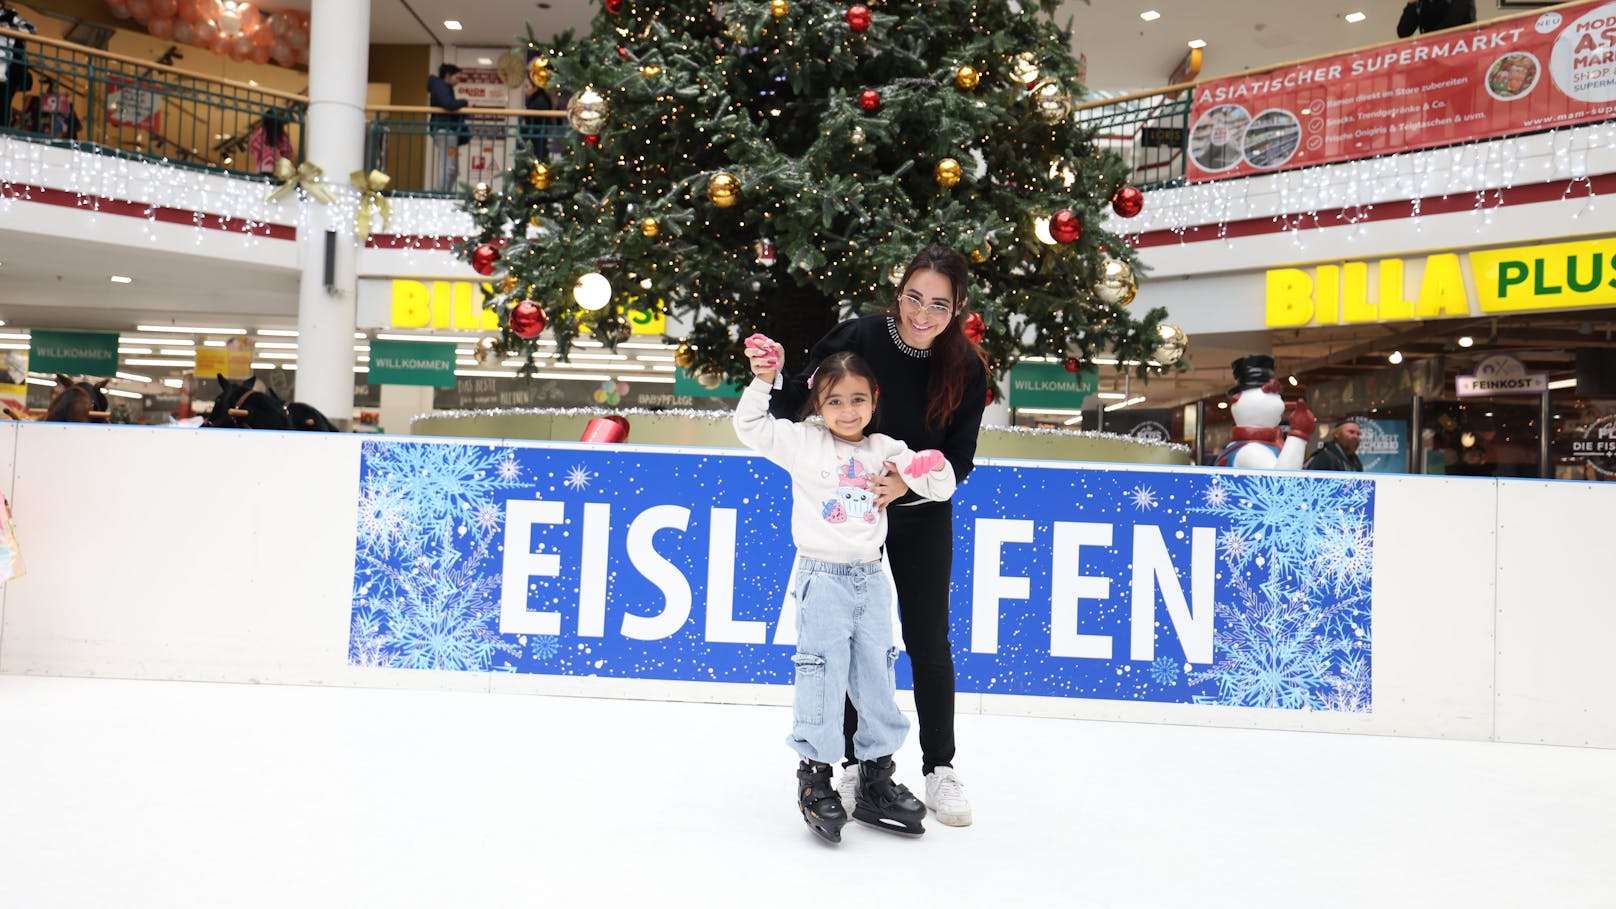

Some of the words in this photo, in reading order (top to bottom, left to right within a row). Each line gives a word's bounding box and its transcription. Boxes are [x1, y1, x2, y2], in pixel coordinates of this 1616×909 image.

[1536, 18, 1560, 28] NEU
[1200, 64, 1342, 104] ASIATISCHER
[1351, 28, 1525, 76] SUPERMARKT
[1574, 50, 1616, 70] MAR
[1573, 68, 1610, 83] SHOP
[1355, 90, 1381, 103] direkt
[1394, 85, 1420, 97] Store
[1421, 76, 1468, 93] zubereiten
[1422, 102, 1430, 111] &
[1432, 100, 1447, 109] Co.
[1354, 125, 1387, 139] Onigiris
[1388, 123, 1397, 133] &
[1399, 116, 1452, 132] Teigtaschen
[1453, 113, 1462, 123] &
[1266, 253, 1470, 328] BILLA
[1497, 252, 1616, 298] PLU
[37, 346, 113, 361] WILLKOMMEN
[375, 358, 450, 371] WILLKOMMEN
[1472, 378, 1532, 391] FEINKOST
[1573, 441, 1593, 451] DIE
[500, 498, 1216, 664] EISLFEN
